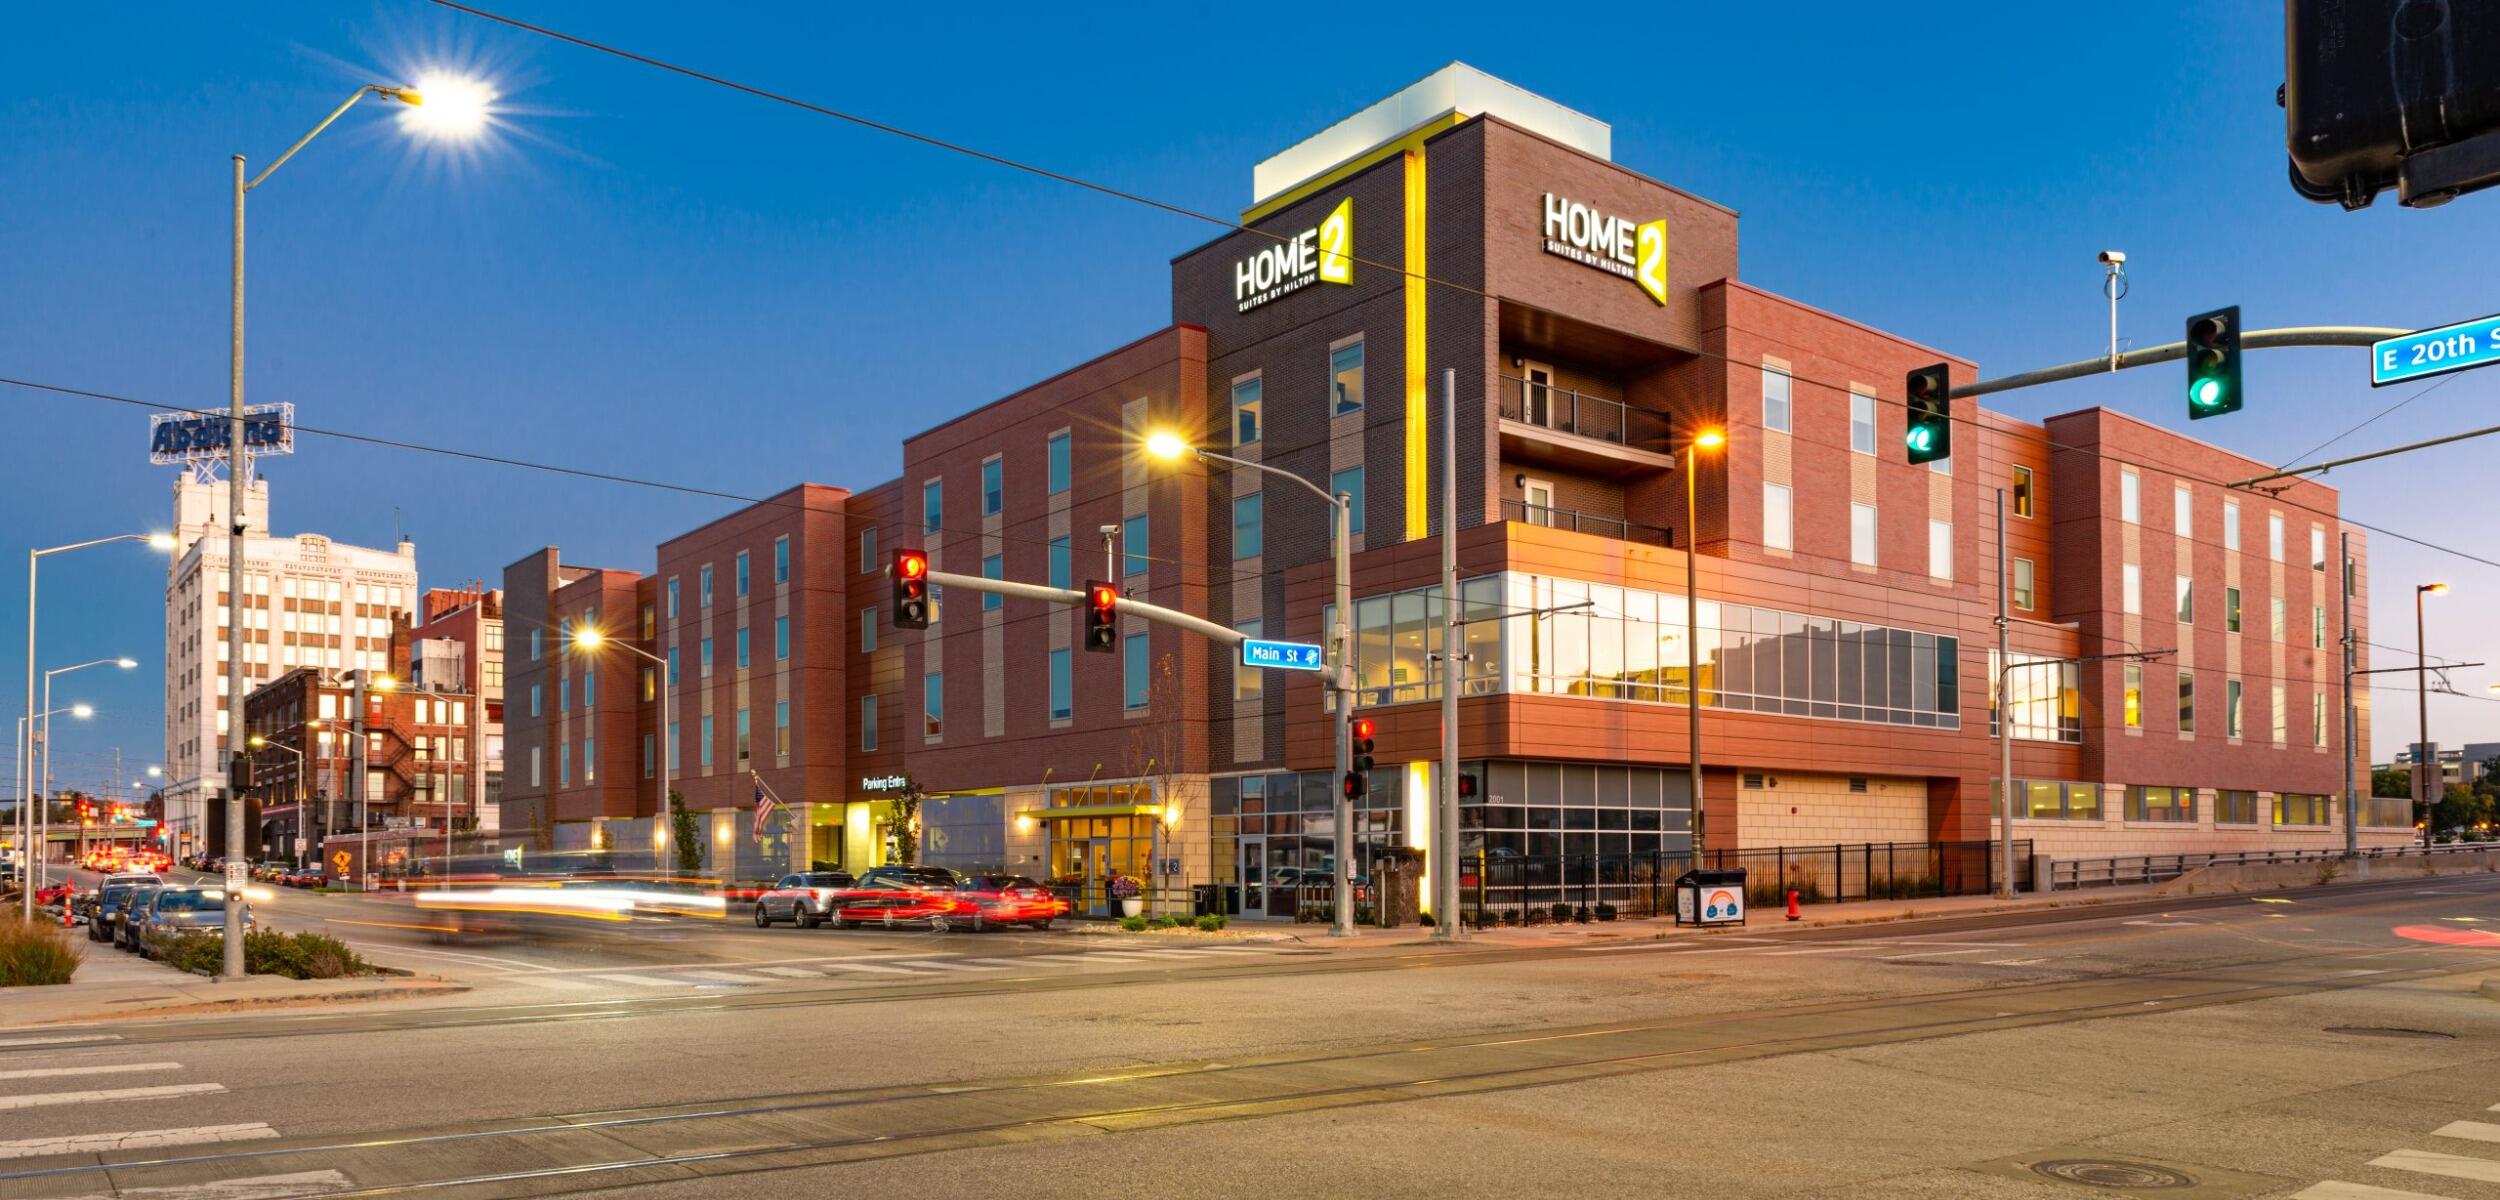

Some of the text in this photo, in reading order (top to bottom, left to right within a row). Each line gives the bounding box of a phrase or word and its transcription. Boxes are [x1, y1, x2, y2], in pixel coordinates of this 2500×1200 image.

[1547, 241, 1634, 277] SUITES BY HILTON
[1238, 273, 1316, 313] SUITES BY HILTON
[2383, 349, 2398, 371] E
[2411, 333, 2476, 366] 20th
[1252, 646, 1298, 663] Main St
[863, 775, 906, 791] Parking Entra
[1488, 795, 1504, 804] 2001
